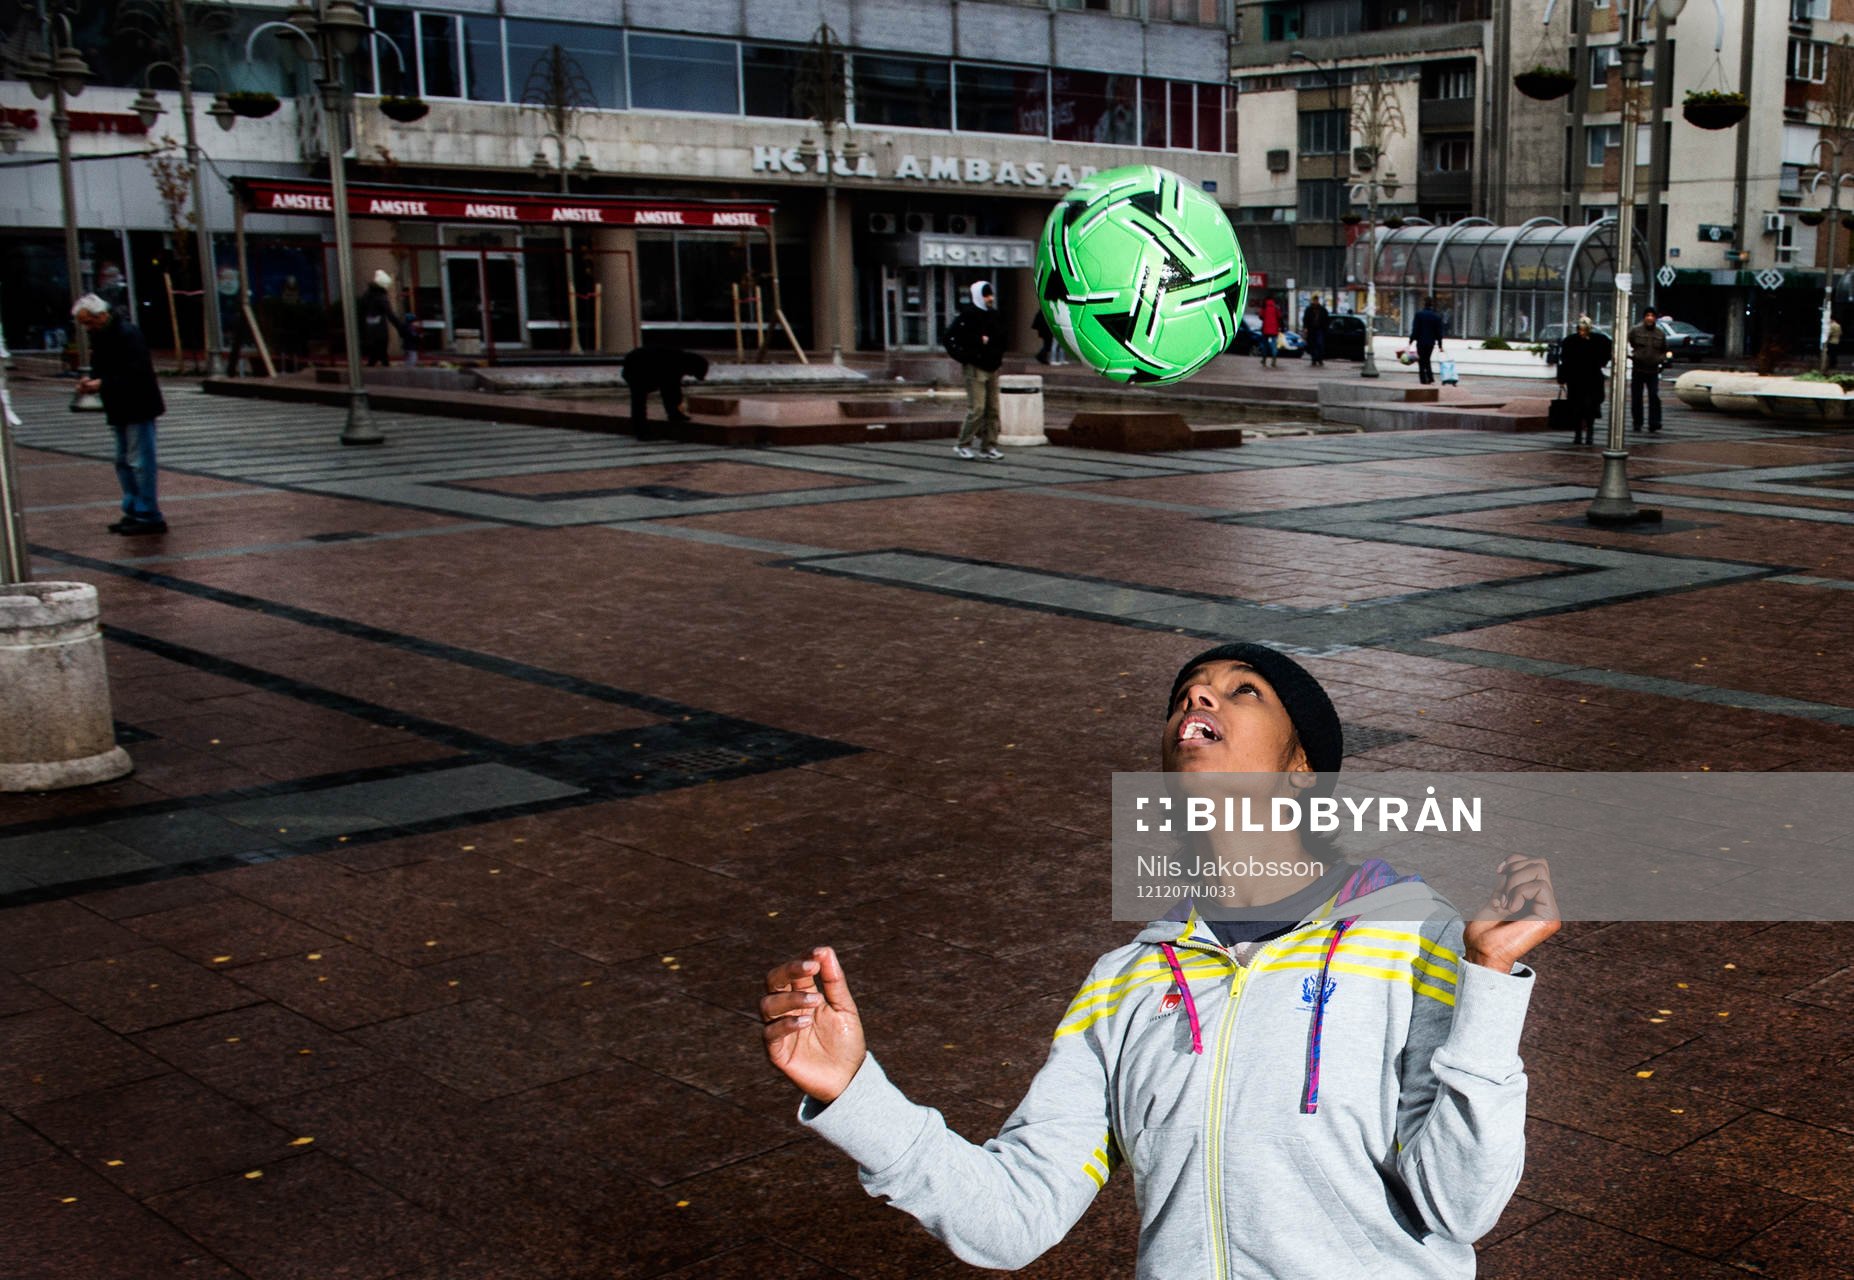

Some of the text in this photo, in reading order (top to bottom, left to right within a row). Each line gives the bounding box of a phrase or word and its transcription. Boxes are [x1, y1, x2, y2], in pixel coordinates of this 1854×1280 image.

[272, 193, 759, 227] AMSTEL AMSTEL AMSTEL AMSTEL AMSTEL AMSTEL
